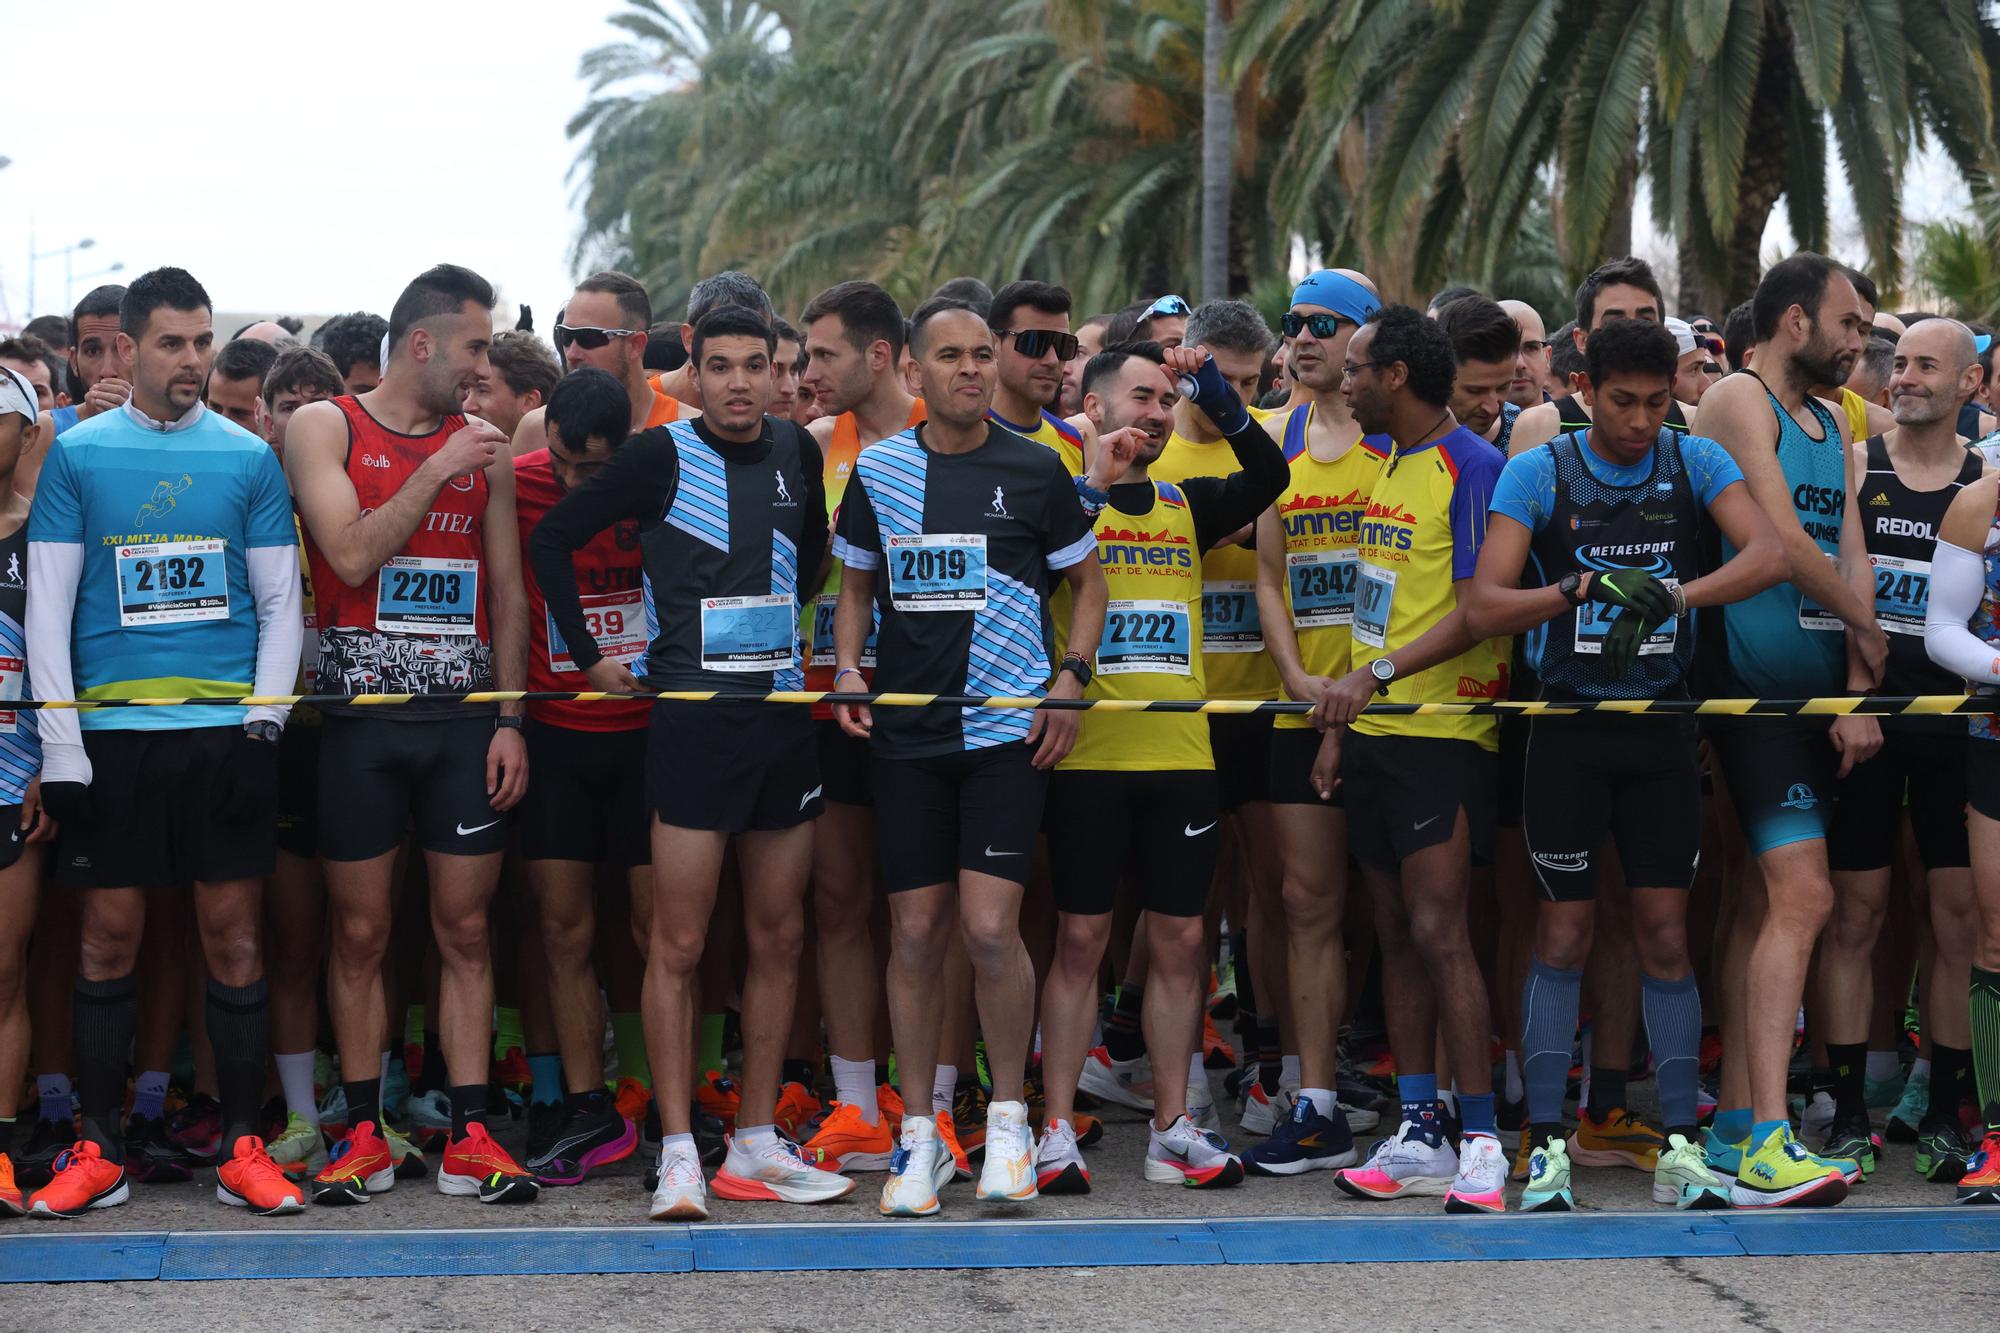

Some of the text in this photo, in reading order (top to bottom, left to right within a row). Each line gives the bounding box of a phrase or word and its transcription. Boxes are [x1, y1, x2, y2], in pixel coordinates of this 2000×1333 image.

[426, 512, 473, 534] TIEL
[1283, 510, 1365, 536] unner
[1875, 517, 1938, 540] REDOL
[102, 535, 122, 546] XXI
[126, 533, 168, 545] MITJA
[1314, 537, 1328, 546] DE
[1332, 534, 1359, 544] VALÈ
[1358, 523, 1414, 550] nners
[1589, 541, 1676, 558] METAESPORT
[900, 549, 967, 581] 2019
[1098, 544, 1192, 568] unners
[135, 556, 205, 591] 2132
[1104, 567, 1193, 579] TAT DE VALÈNCIA
[1300, 565, 1357, 597] 2342
[392, 571, 461, 604] 2203
[1875, 571, 1929, 606] 247
[1109, 613, 1176, 644] 2222
